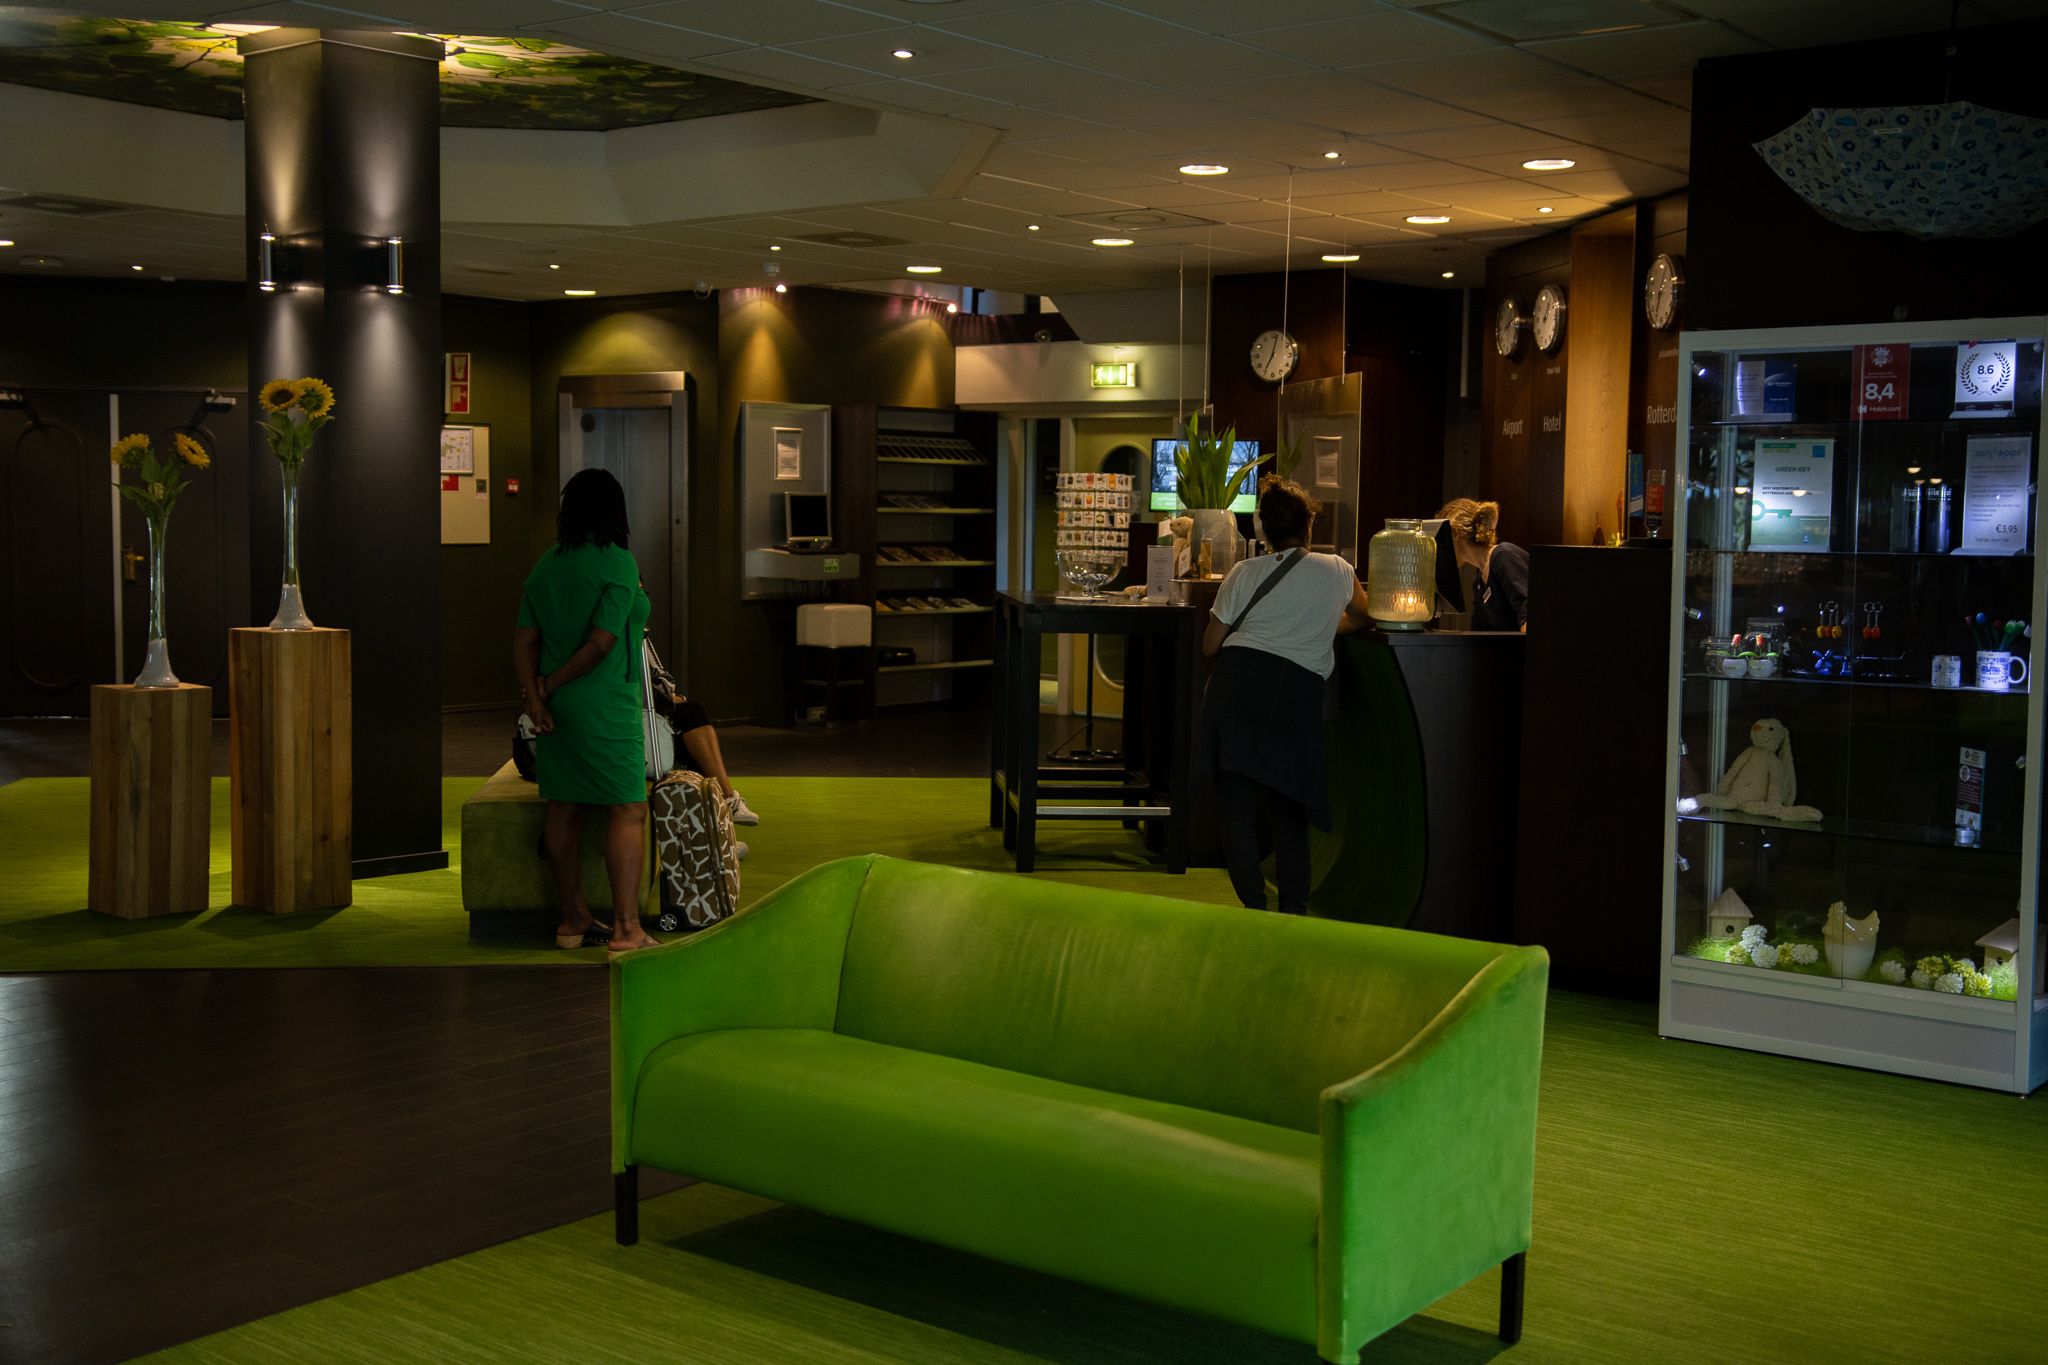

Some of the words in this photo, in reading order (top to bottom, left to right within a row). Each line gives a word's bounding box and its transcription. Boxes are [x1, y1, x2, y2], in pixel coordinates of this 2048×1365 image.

[1977, 364, 1995, 375] 8.6
[1865, 382, 1895, 402] 8,4
[1543, 412, 1562, 433] Hotel
[1647, 401, 1677, 425] Rotterd
[1502, 418, 1523, 440] Airport
